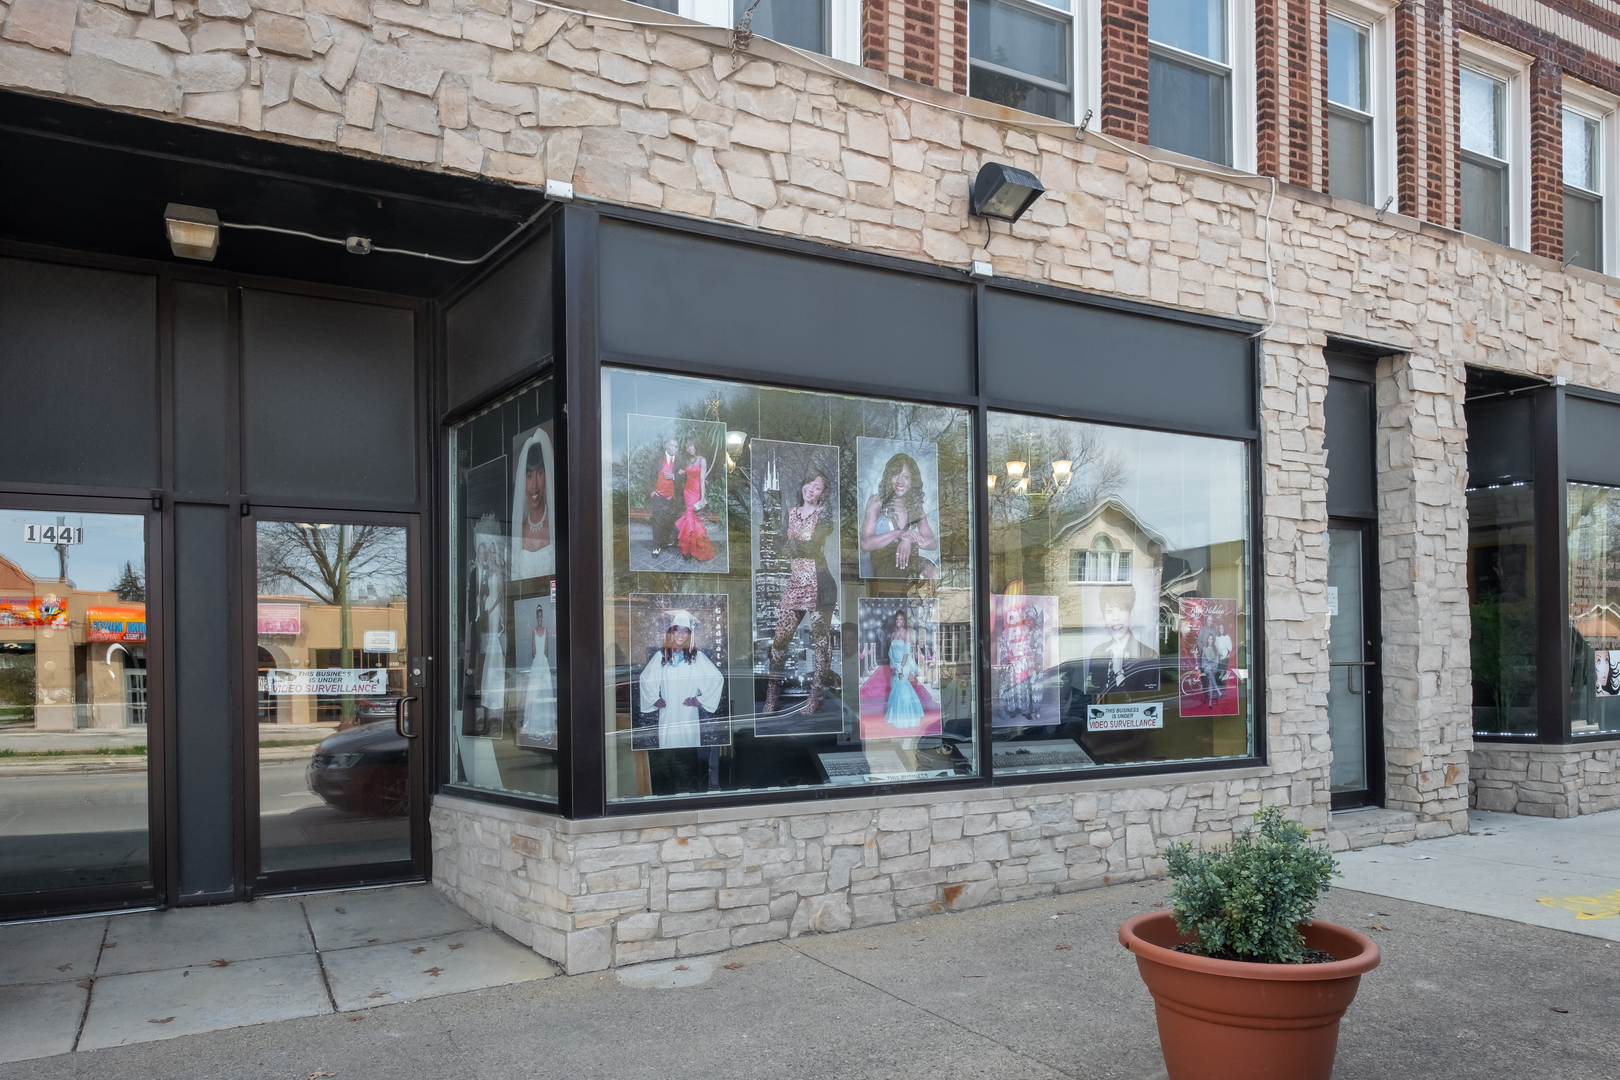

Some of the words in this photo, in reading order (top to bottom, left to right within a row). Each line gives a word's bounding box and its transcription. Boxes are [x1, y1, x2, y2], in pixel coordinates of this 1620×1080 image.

[27, 525, 82, 543] 1441
[272, 684, 303, 693] VIDEO
[304, 684, 378, 693] SURVEILLANCE
[1089, 720, 1109, 729] VIDEO
[1110, 719, 1157, 728] SURVEILLANCE
